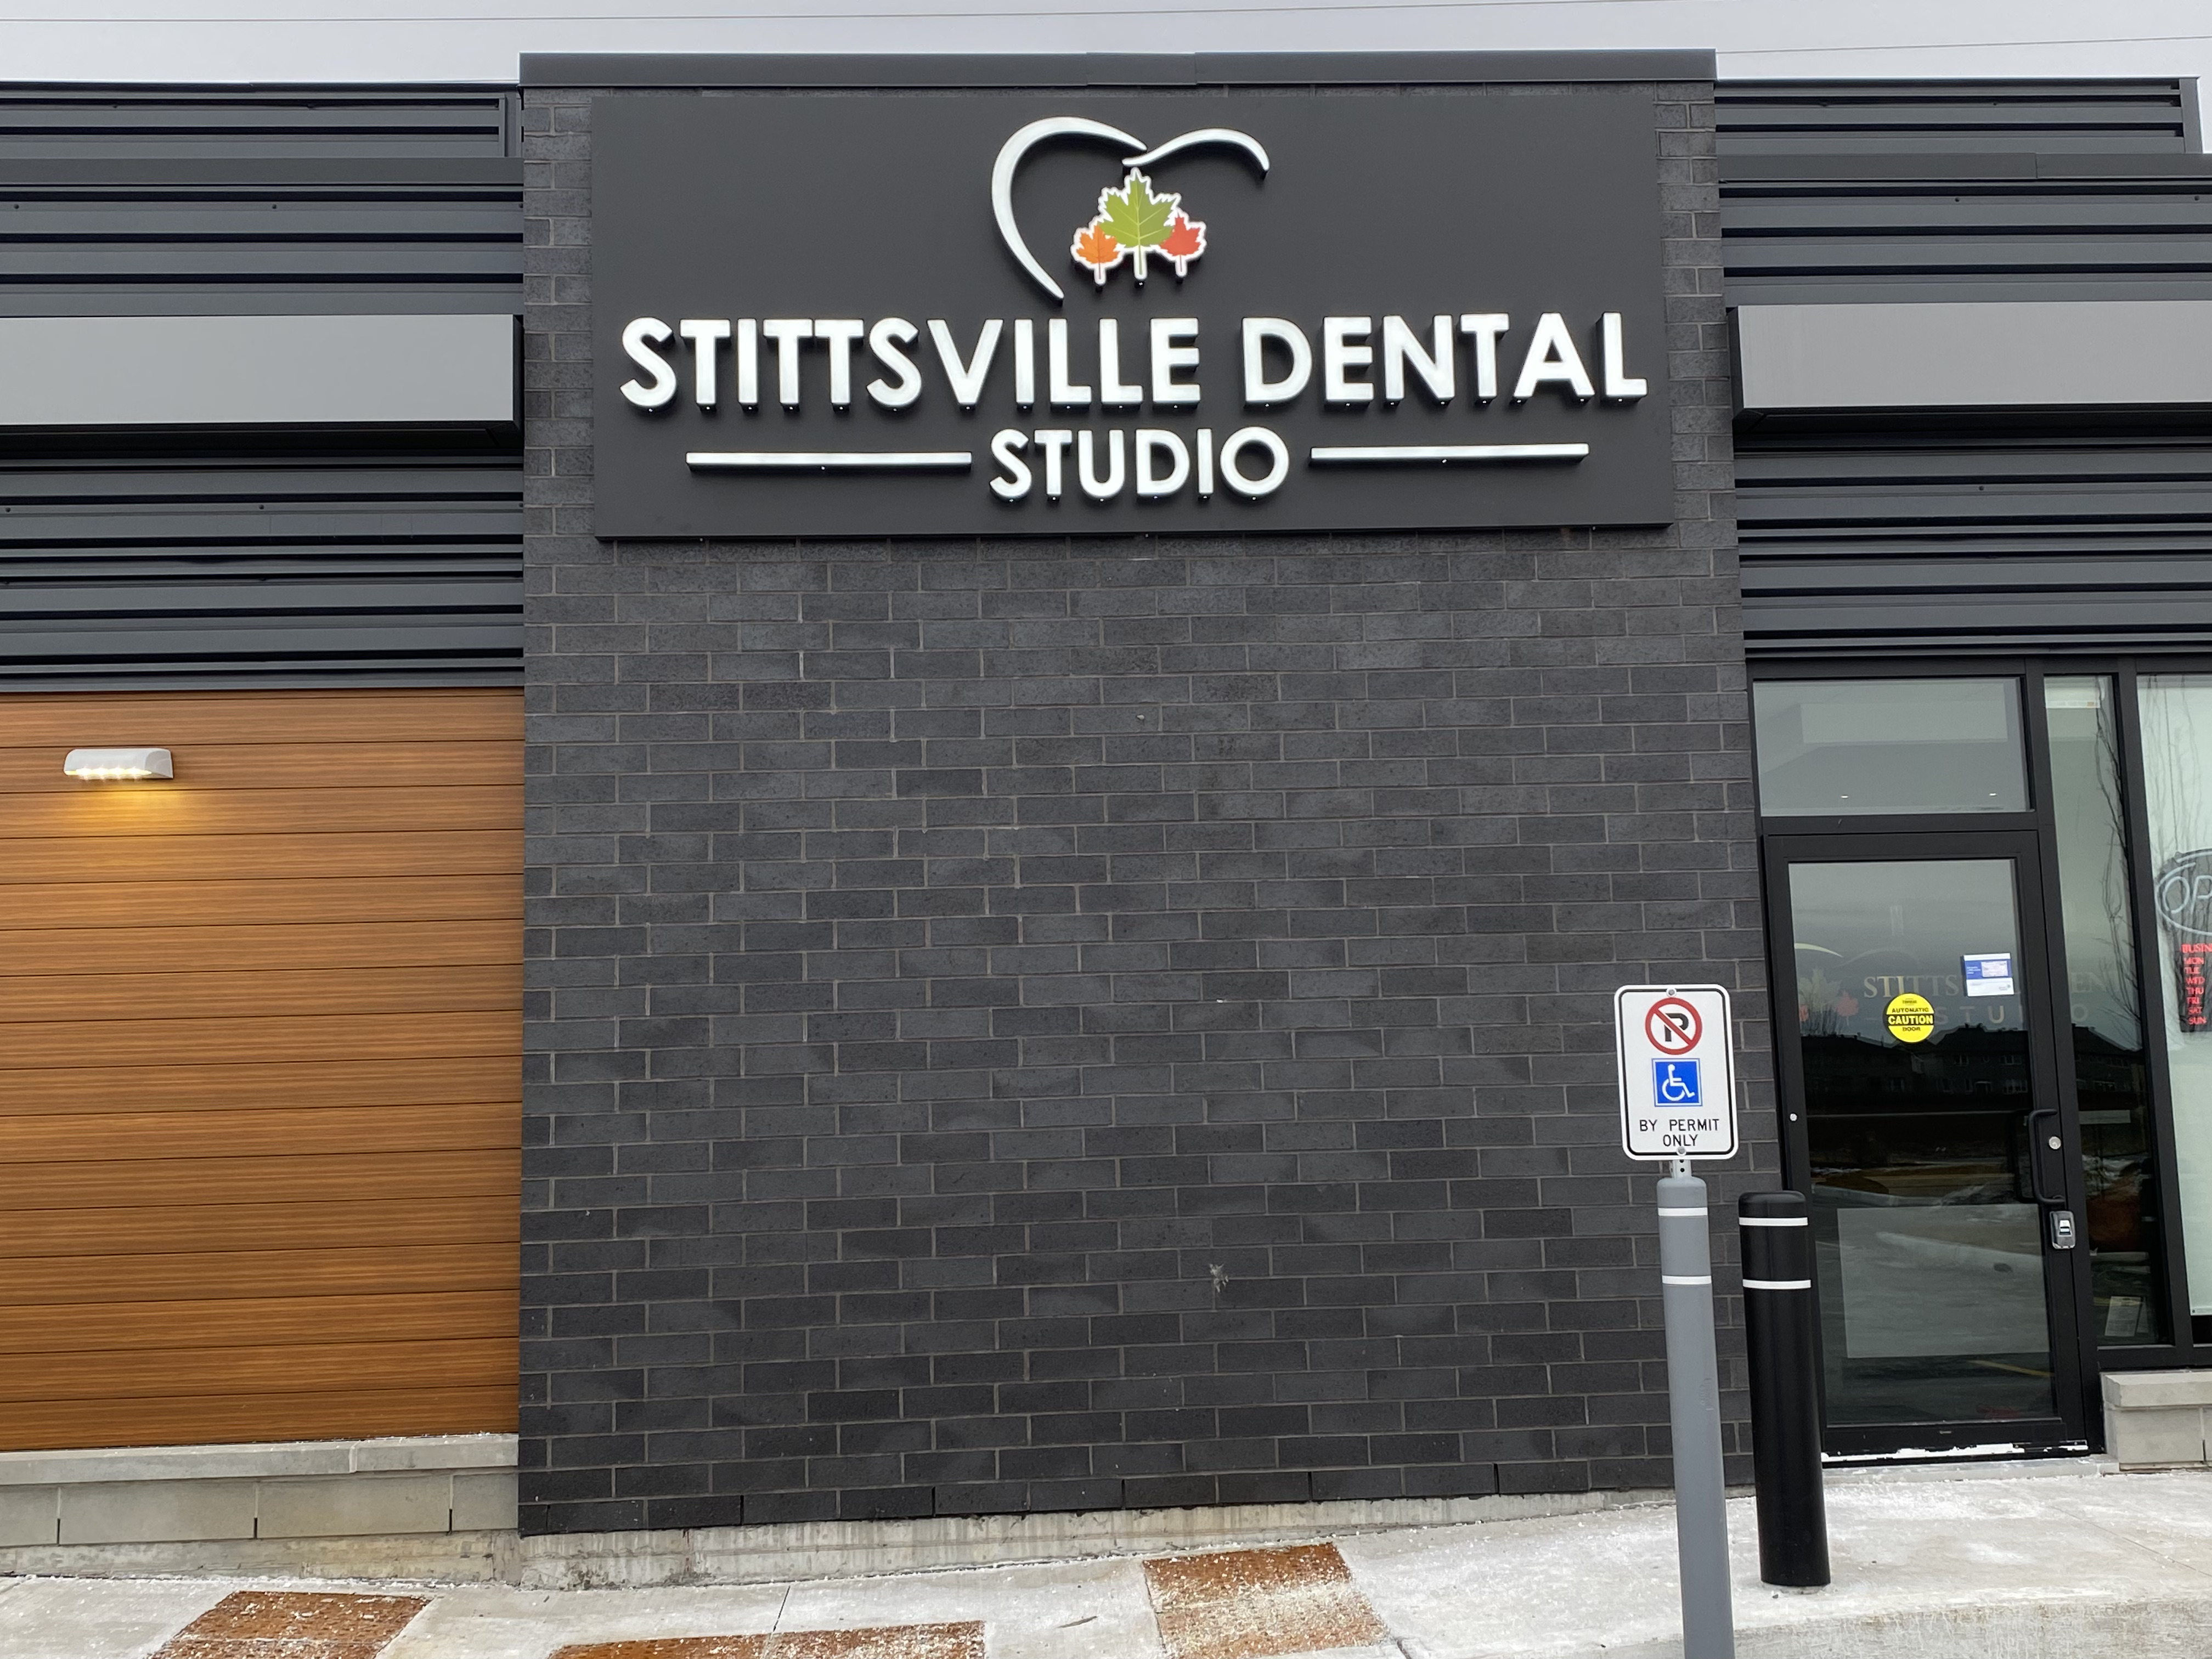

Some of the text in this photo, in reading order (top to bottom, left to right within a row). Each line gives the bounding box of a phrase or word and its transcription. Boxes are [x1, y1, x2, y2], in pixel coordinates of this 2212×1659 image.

[620, 312, 1647, 408] STITTSVILLE DENTAL
[990, 426, 1289, 500] STUDIO
[2185, 977, 2205, 985] WED
[1888, 1014, 1933, 1025] CAUTION
[2188, 1017, 2207, 1025] SUN
[1639, 1119, 1720, 1132] BY PERMIT
[1663, 1134, 1699, 1147] ONLY
